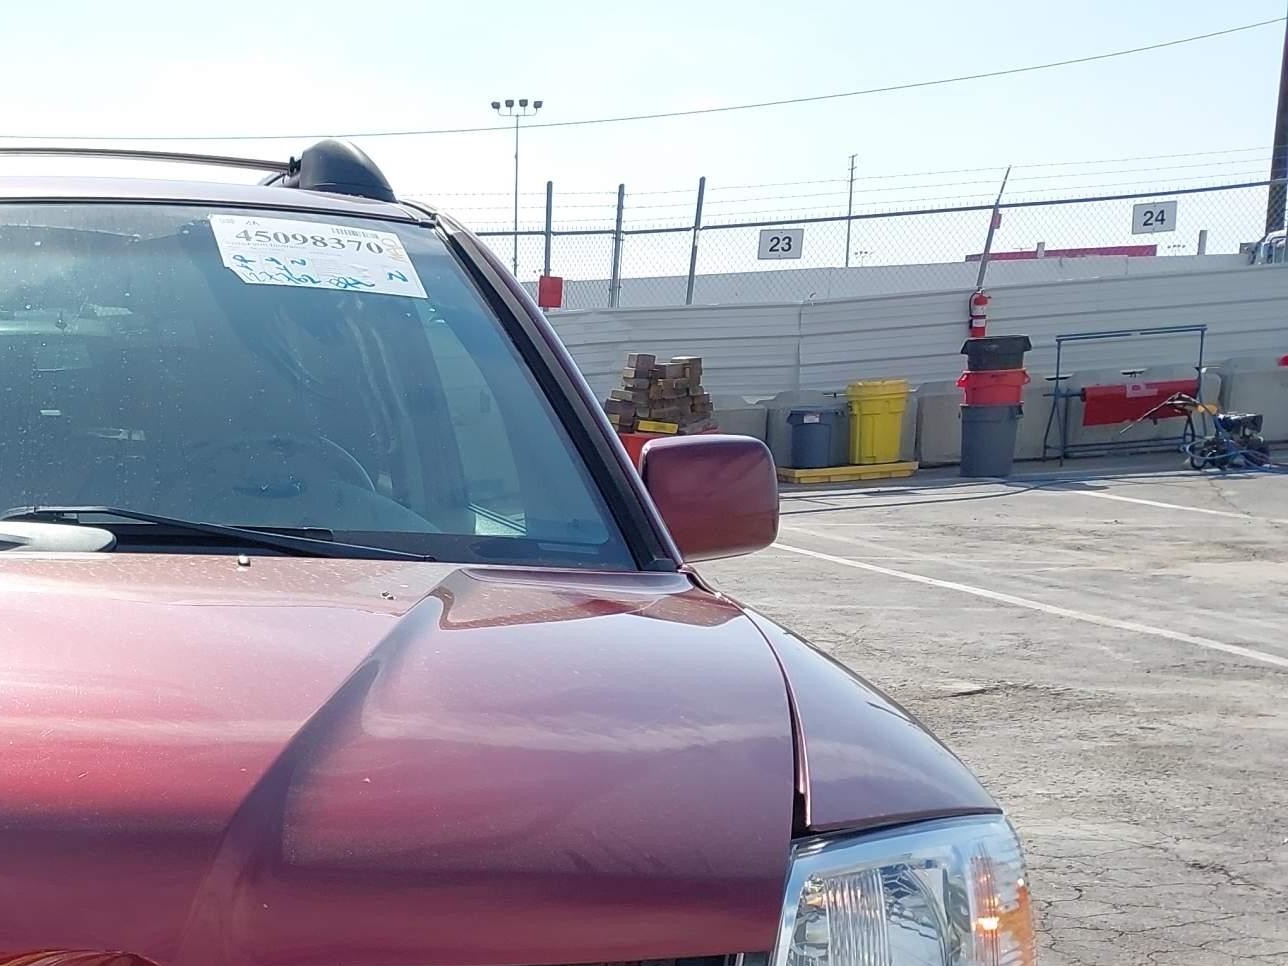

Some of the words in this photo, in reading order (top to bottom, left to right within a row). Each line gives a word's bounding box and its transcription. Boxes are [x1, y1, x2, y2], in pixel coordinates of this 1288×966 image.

[1142, 209, 1166, 226] 24
[235, 229, 384, 254] 45098370
[768, 235, 792, 252] 23
